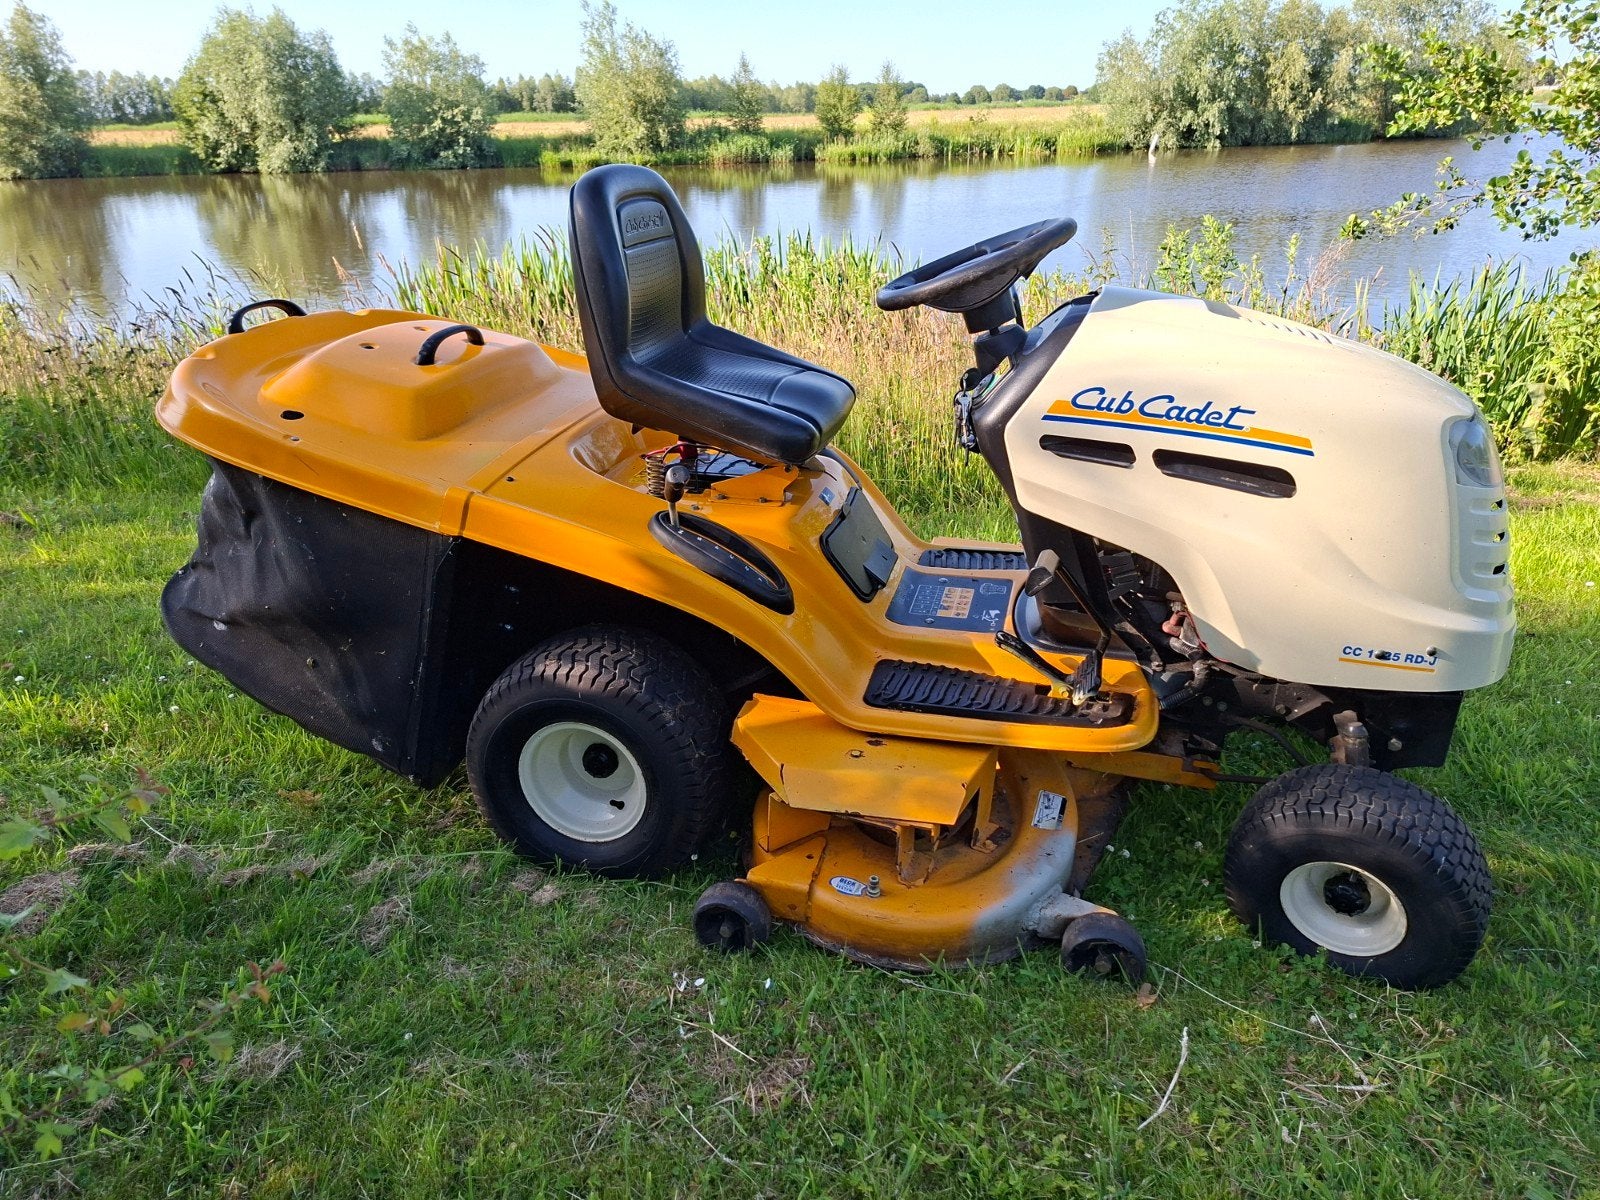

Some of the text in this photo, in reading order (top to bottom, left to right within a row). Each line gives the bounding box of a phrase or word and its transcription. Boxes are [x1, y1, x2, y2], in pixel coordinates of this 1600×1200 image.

[1071, 386, 1257, 431] Cub Cadet
[1342, 645, 1438, 666] CC 125 RD-J
